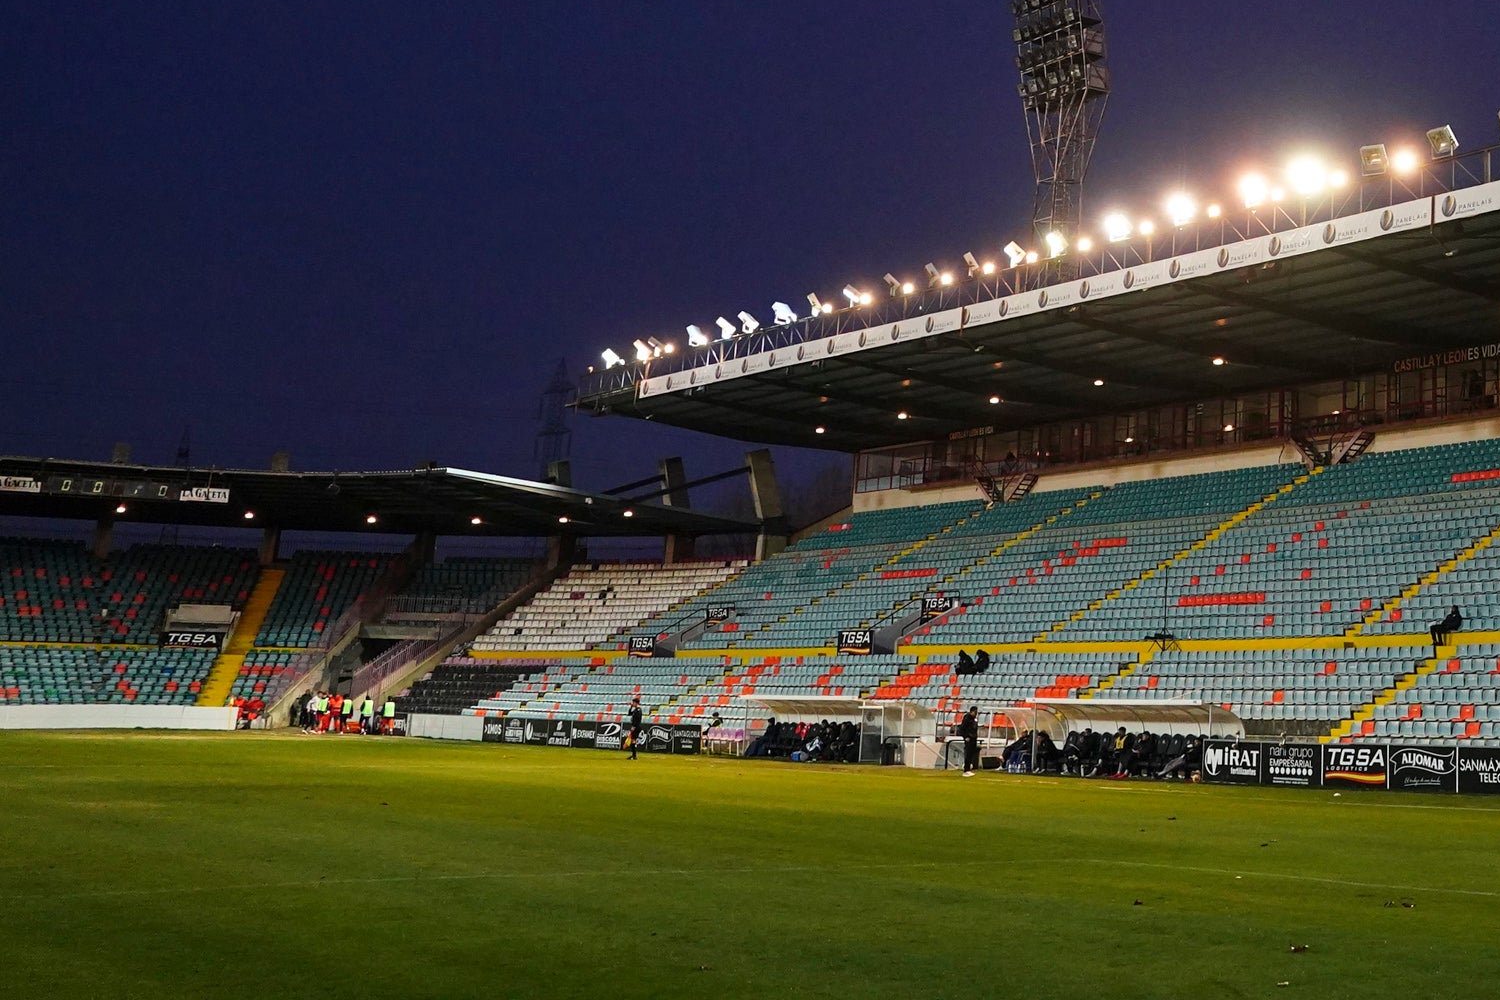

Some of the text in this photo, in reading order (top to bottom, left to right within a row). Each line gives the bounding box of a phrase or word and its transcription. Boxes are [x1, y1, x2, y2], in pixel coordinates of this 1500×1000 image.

[1459, 198, 1492, 211] PANELAIS
[1468, 347, 1480, 360] ES
[61, 479, 168, 496] 0 0 0
[925, 598, 951, 608] TGSA
[168, 633, 217, 644] TGSA
[632, 637, 653, 648] TGSA
[841, 632, 870, 644] TGSA
[1288, 747, 1313, 759] grupo
[1328, 748, 1384, 766] TGSA
[1269, 758, 1313, 768] EMPRESARIAL
[1401, 753, 1445, 771] ALJOMAR
